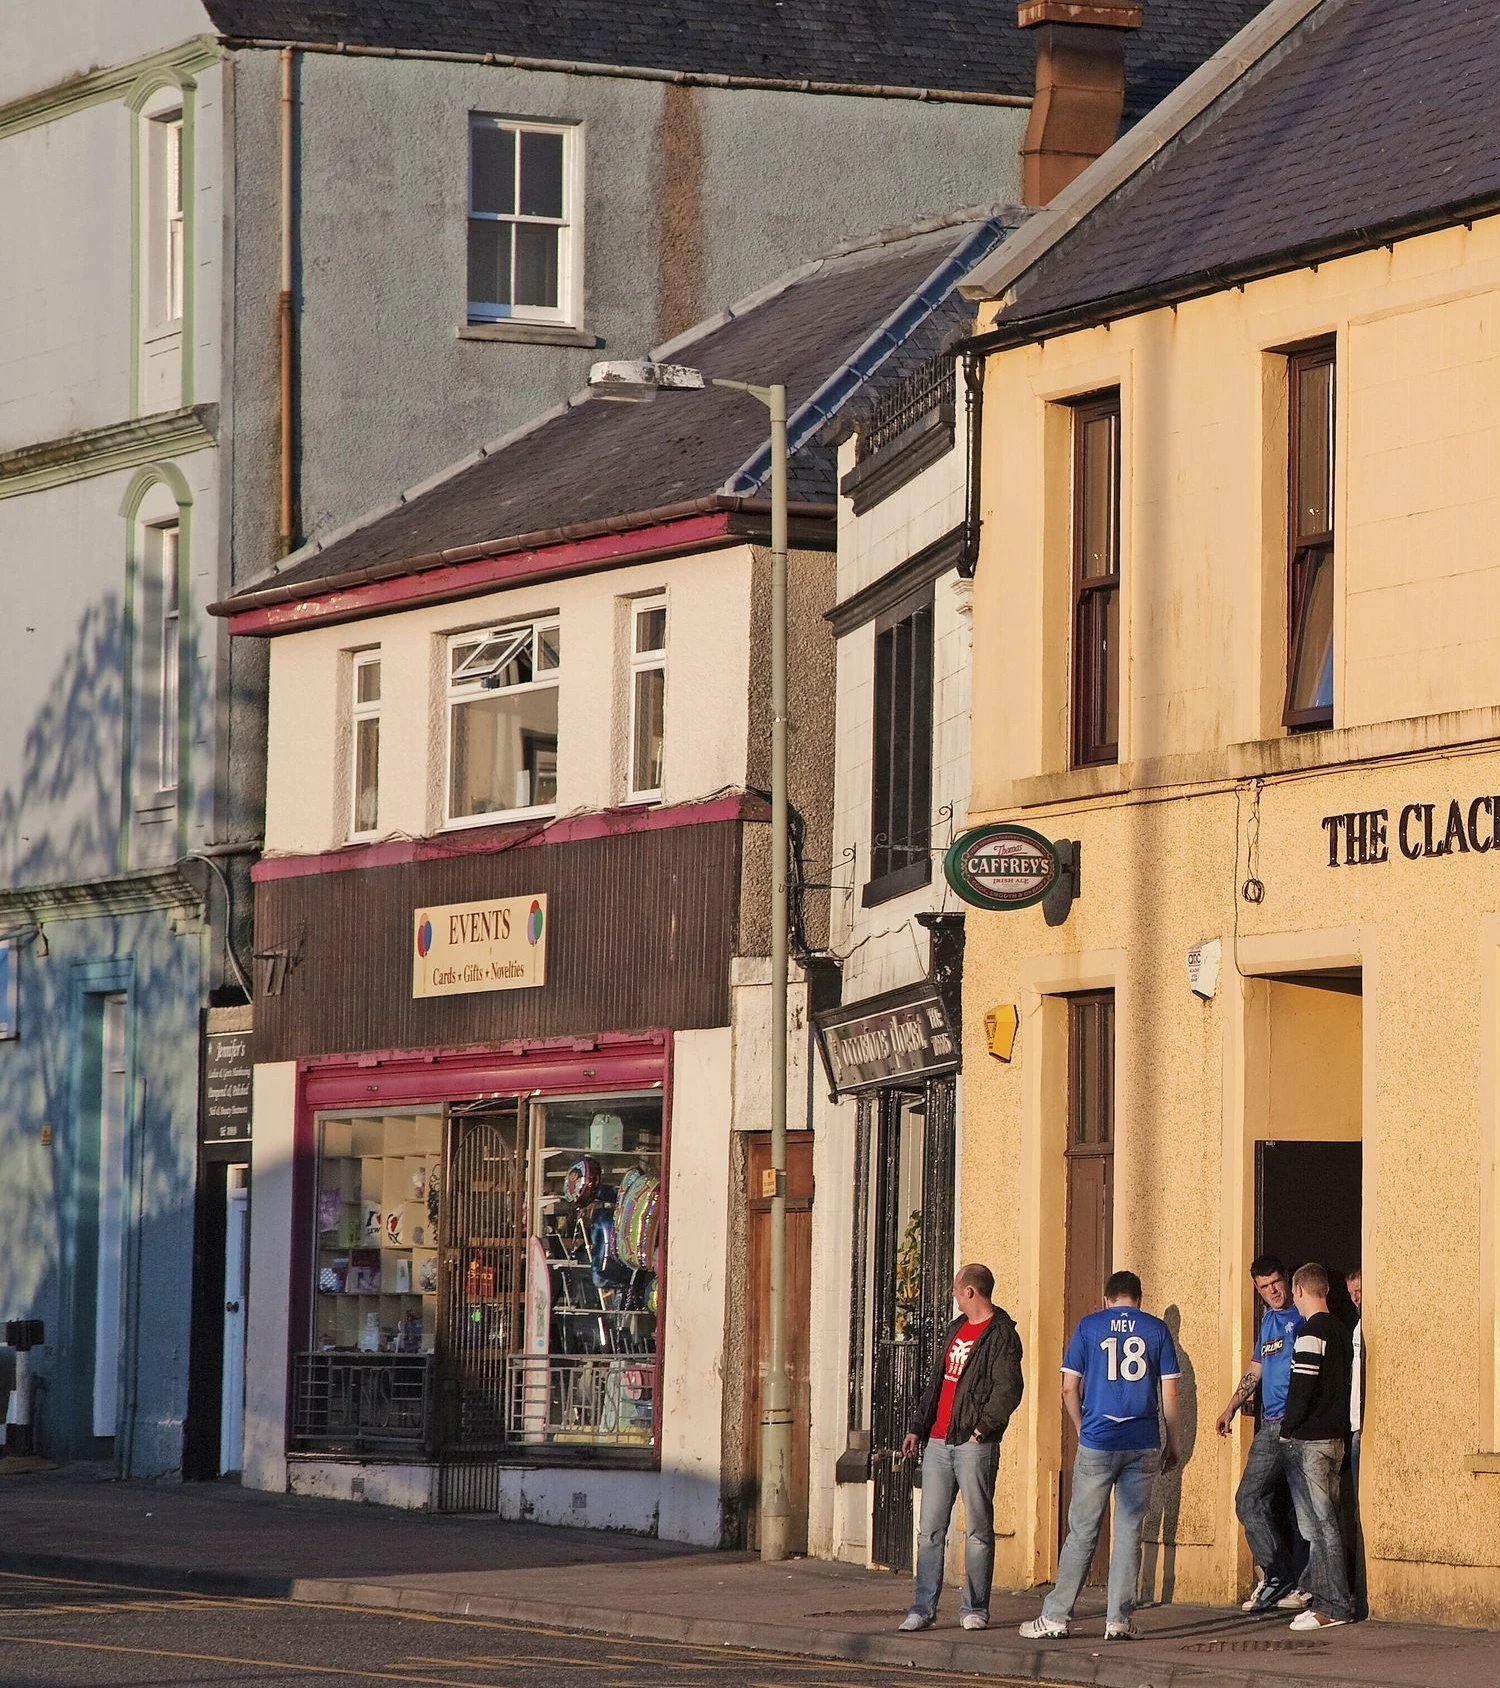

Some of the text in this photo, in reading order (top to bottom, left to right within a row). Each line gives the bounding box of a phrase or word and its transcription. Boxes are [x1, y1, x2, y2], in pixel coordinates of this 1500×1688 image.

[993, 843, 1023, 855] Thomas
[1322, 808, 1389, 868] THE
[968, 857, 1050, 874] CAFFREY'S
[448, 908, 511, 945] EVENTS
[432, 960, 525, 986] Cards Gifts Novelties
[1110, 1319, 1136, 1333] MEV
[1099, 1335, 1147, 1382] 18
